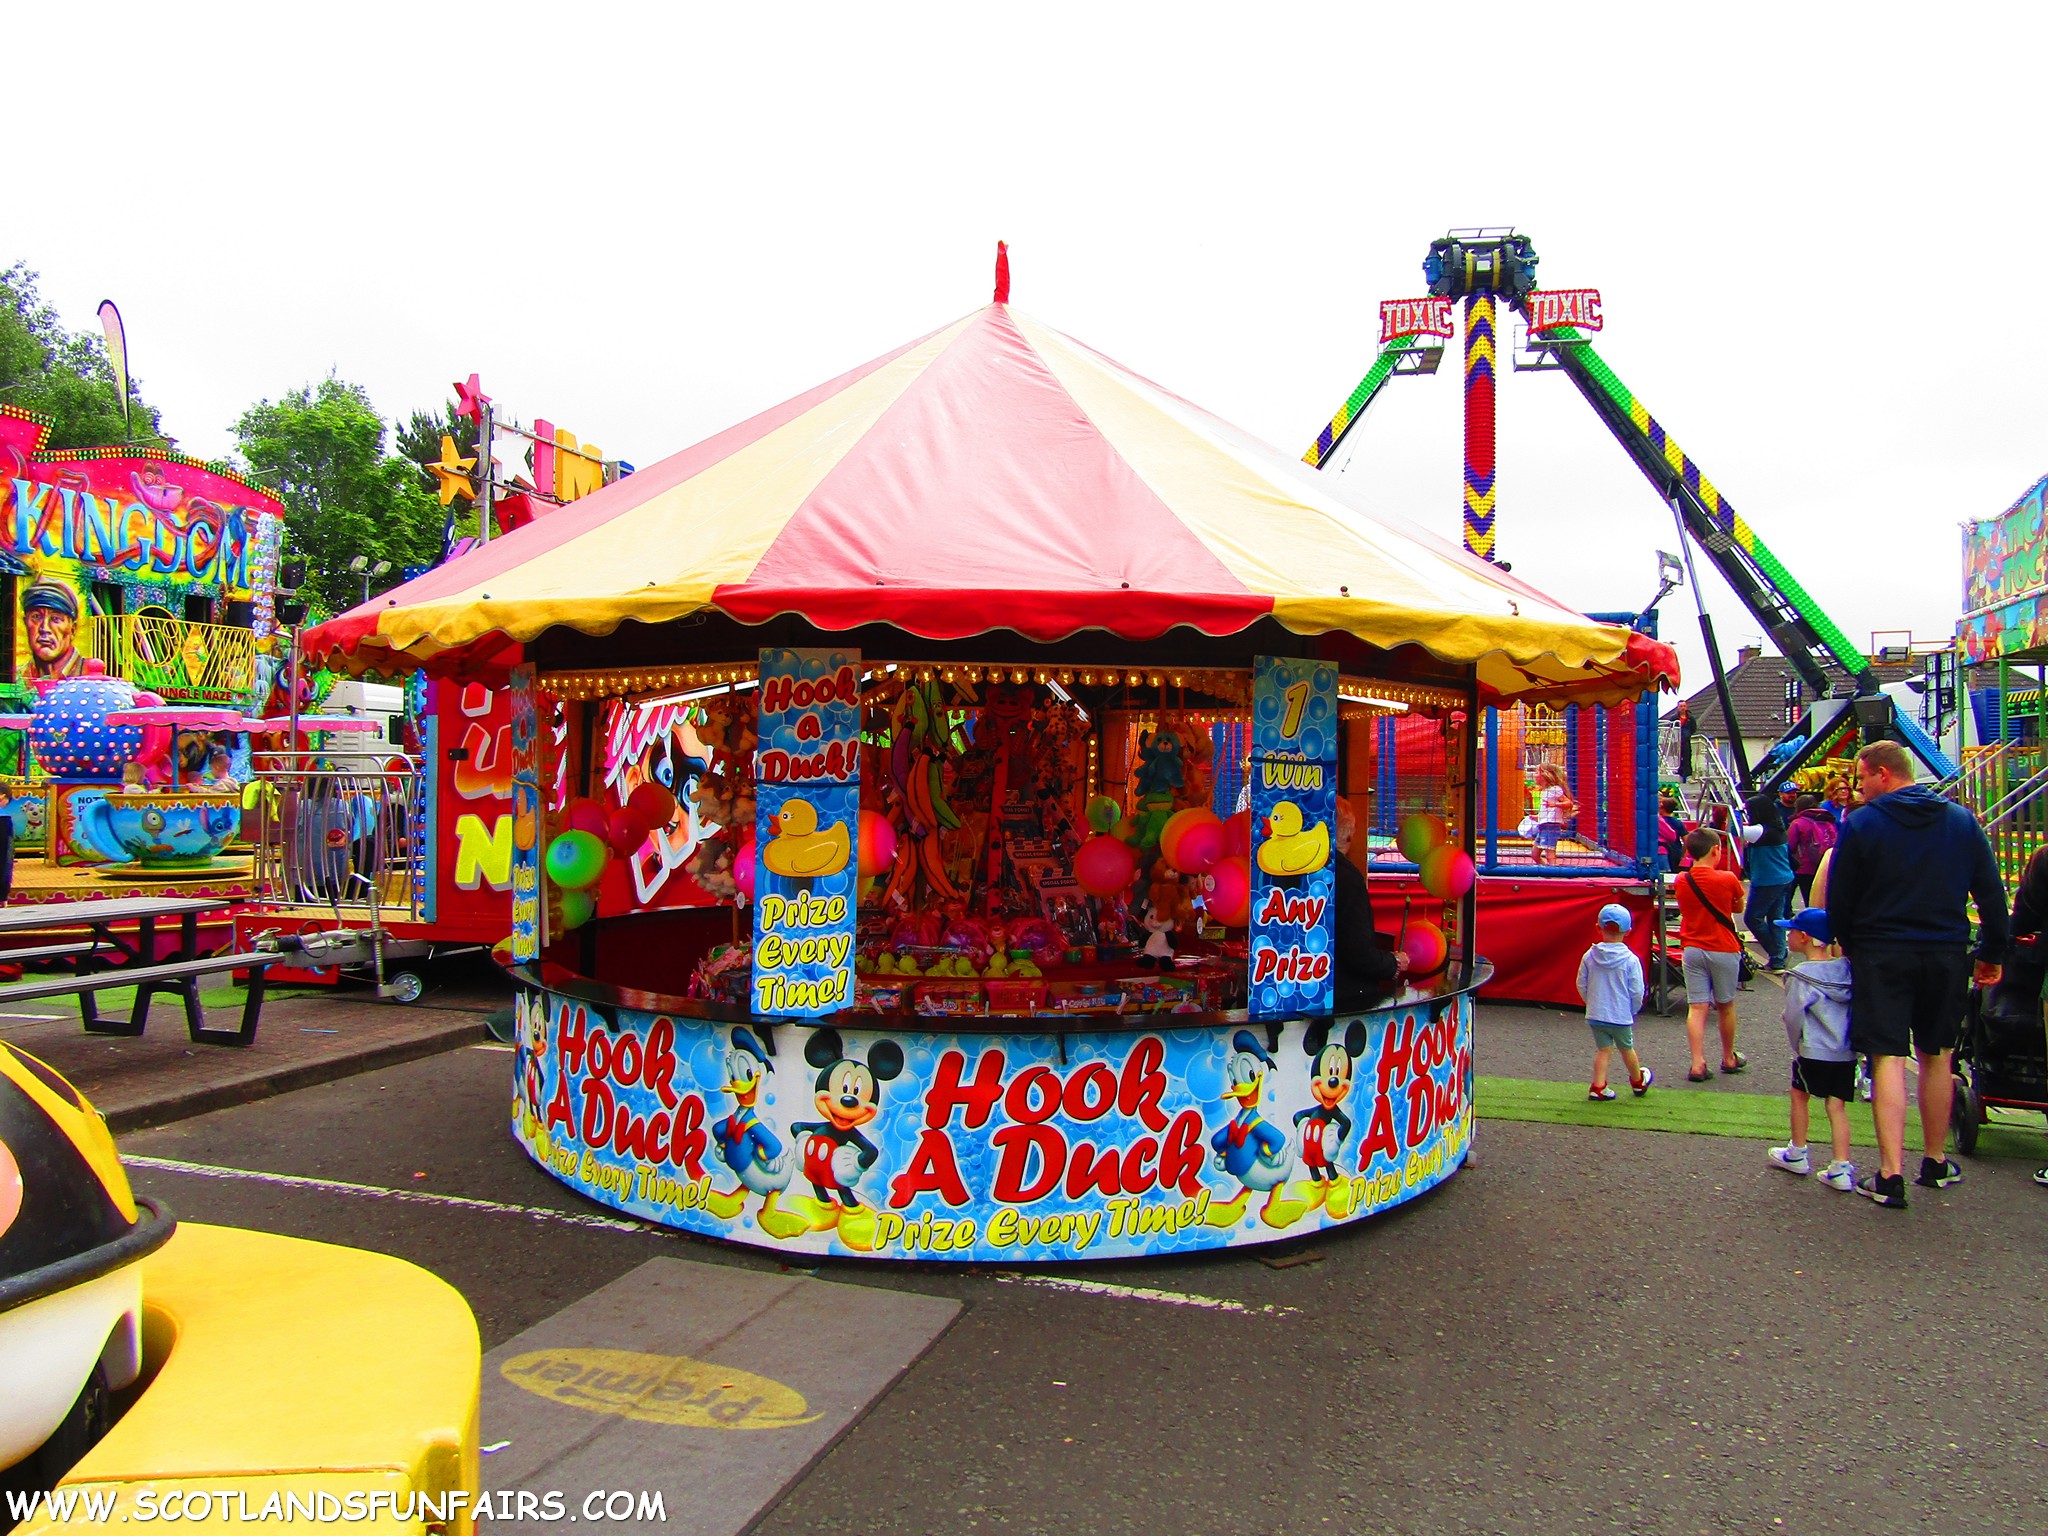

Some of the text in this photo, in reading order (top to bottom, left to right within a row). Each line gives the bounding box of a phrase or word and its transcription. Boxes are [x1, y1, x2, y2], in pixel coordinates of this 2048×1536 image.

[1383, 300, 1451, 338] TOXIC
[1530, 292, 1600, 329] TOXIC
[10, 479, 250, 589] KINGDOM
[2006, 498, 2039, 548] TIC
[2001, 540, 2042, 597] TOC
[156, 686, 232, 701] JUNGLE MAZE
[763, 667, 859, 714] Hook
[1282, 683, 1308, 739] 1
[797, 715, 821, 741] a
[762, 740, 859, 783] Duck!
[1264, 753, 1321, 788] Win
[763, 893, 846, 931] Prize
[1261, 889, 1325, 930] Any
[758, 935, 850, 970] Every
[1255, 947, 1328, 983] Prize
[757, 969, 848, 1011] Time!
[557, 1004, 679, 1110] Hook
[1377, 994, 1460, 1095] Hook
[925, 1036, 1170, 1133] Hook
[547, 1068, 707, 1183] A Duck
[1358, 1093, 1399, 1173] A
[581, 1150, 634, 1202] Every
[636, 1165, 712, 1212] Time!
[889, 1110, 1206, 1209] A Duck
[1349, 1168, 1401, 1214] Prize
[1405, 1140, 1443, 1188] Every
[874, 1189, 1211, 1251] Prize Every Time!
